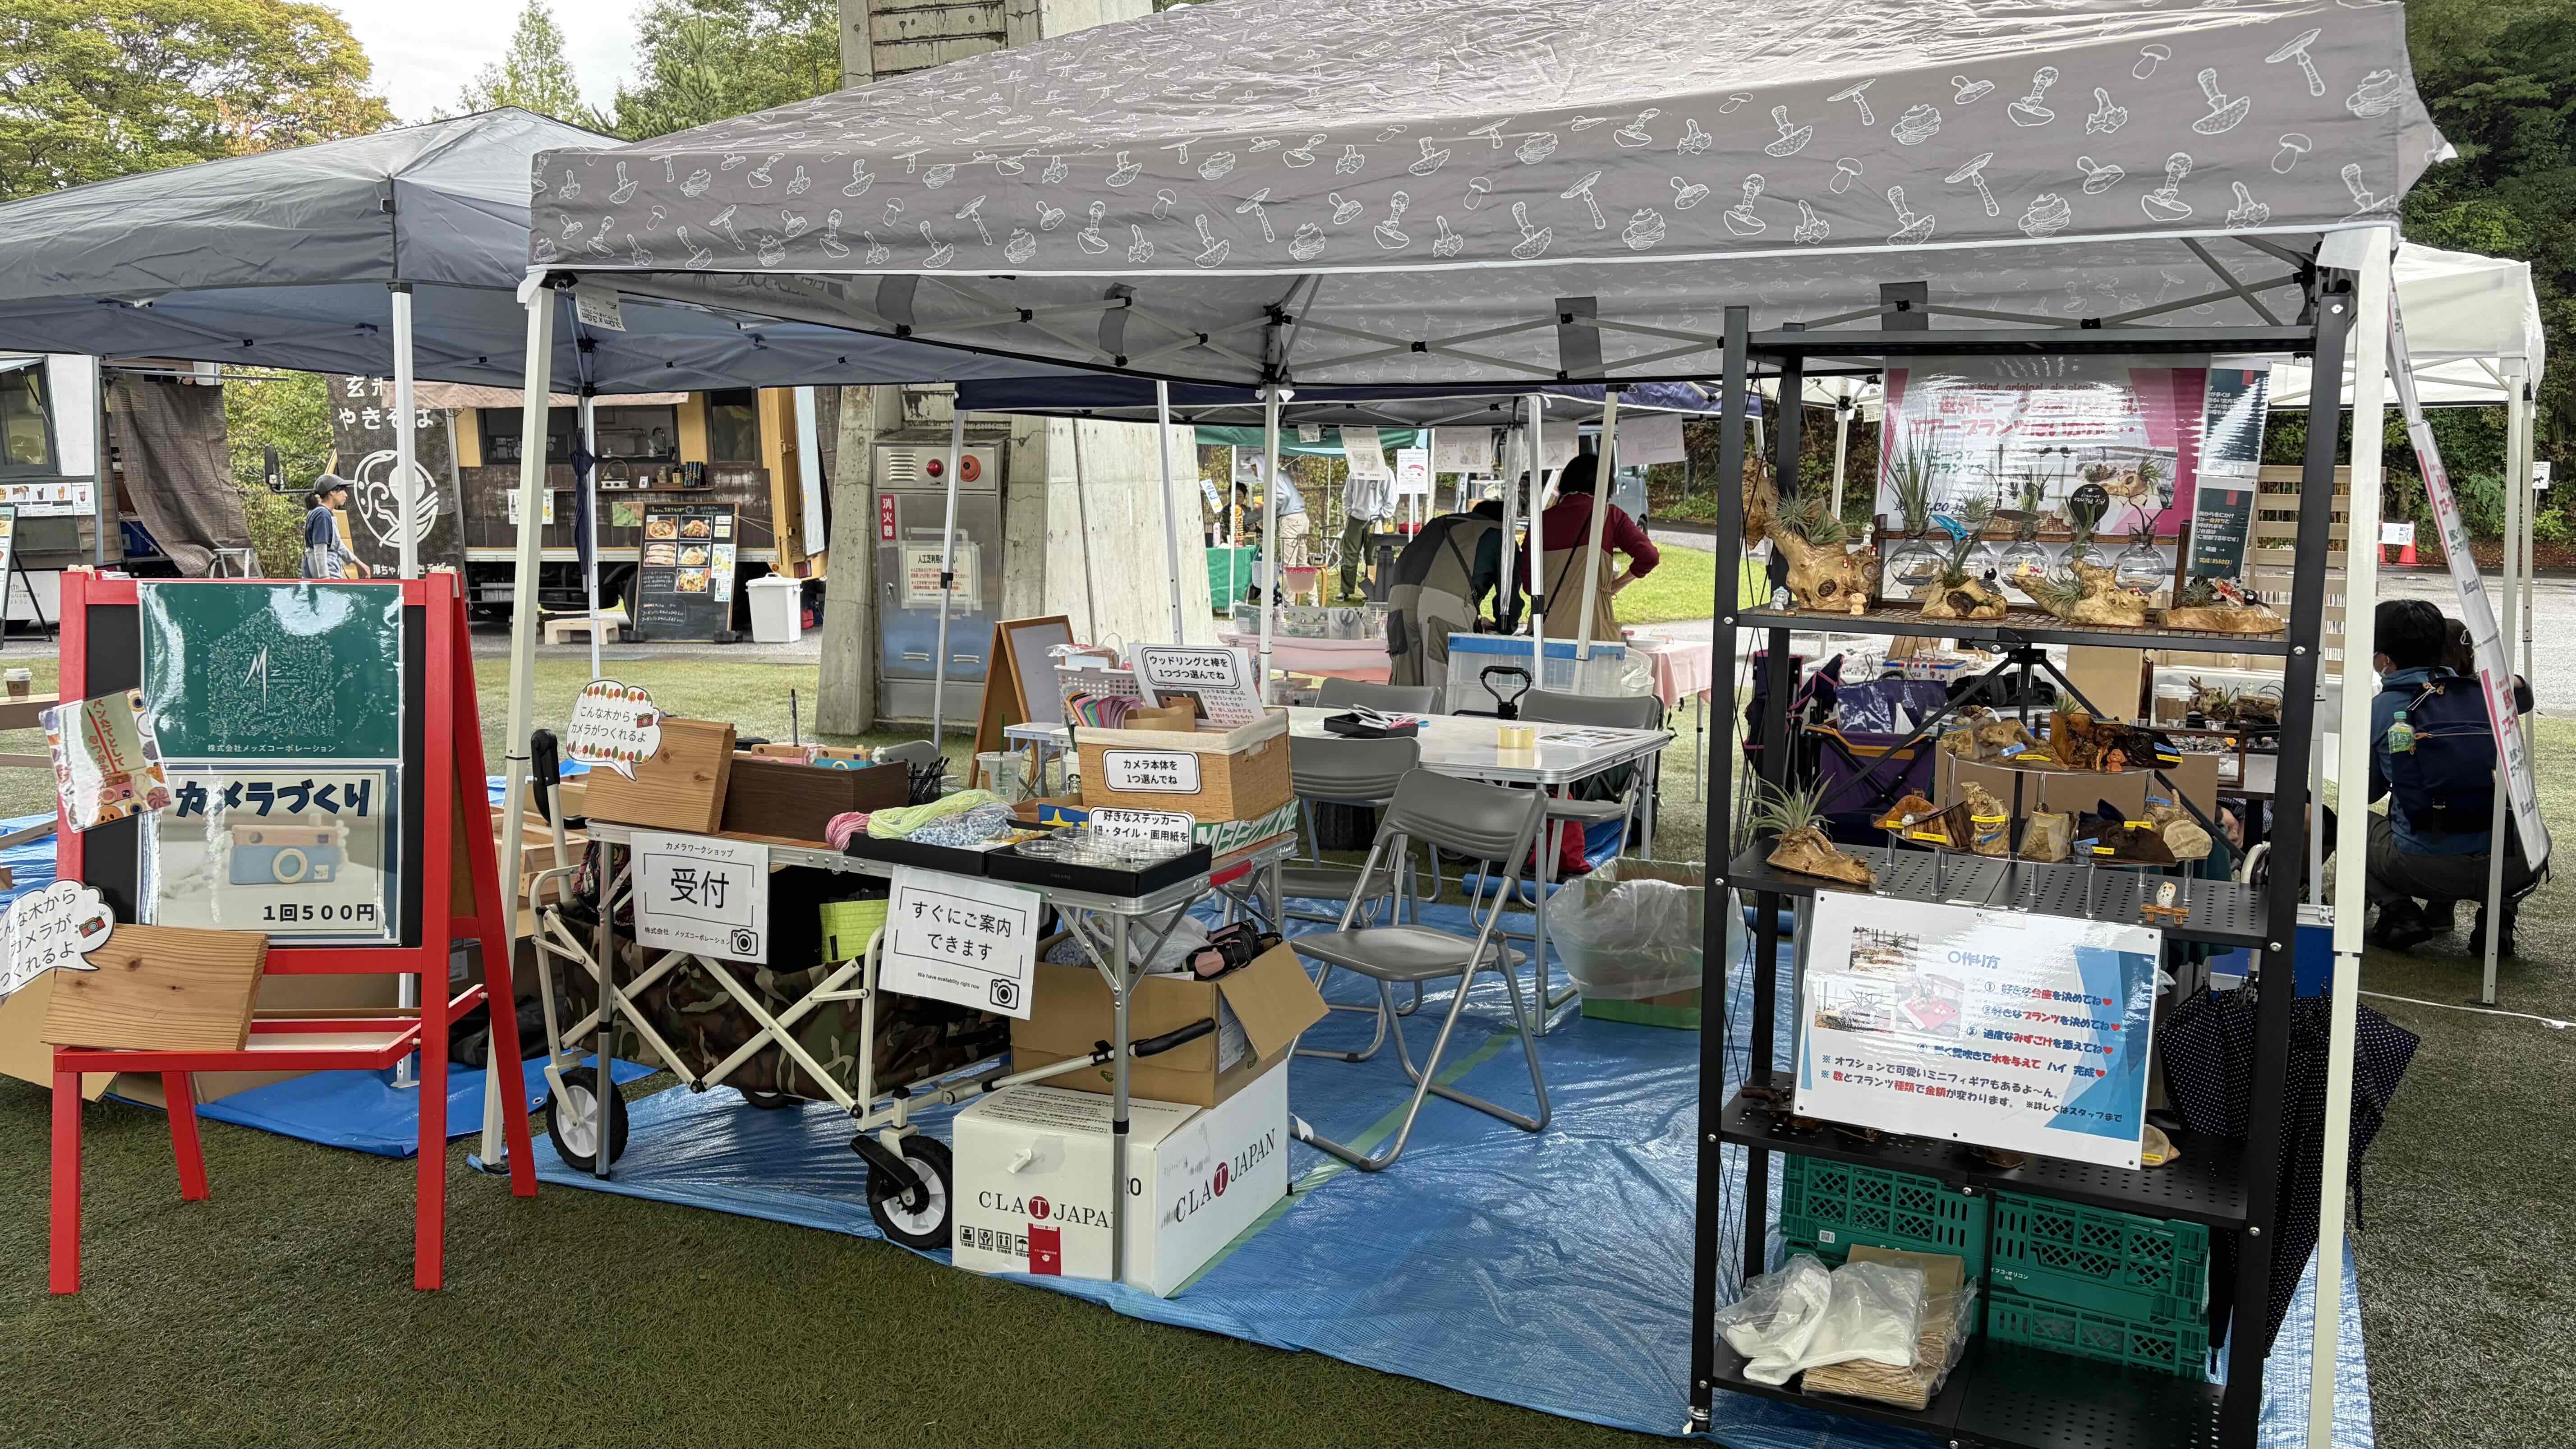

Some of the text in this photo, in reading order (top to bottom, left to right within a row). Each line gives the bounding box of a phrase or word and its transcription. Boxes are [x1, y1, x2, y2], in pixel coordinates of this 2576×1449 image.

[883, 498, 893, 537] 消火器
[1149, 655, 1229, 667] ウッドリングと棒を
[1159, 669, 1226, 680] 1つづつ選んでね
[580, 707, 630, 722] こんな木から
[571, 722, 647, 743] カメラがつくれるよ
[207, 744, 336, 752] 株式会社メッズコーポレーション
[1123, 759, 1178, 771] カメラ本体を
[1127, 774, 1178, 785] 1つ選んでね
[175, 779, 371, 818] カメラづくり
[1103, 810, 1180, 825] 好きなステッカー
[666, 842, 734, 857] カメラワークショップ
[670, 868, 730, 909] 受付
[0, 889, 76, 942] んな木から
[262, 903, 375, 922] 1回500円
[912, 901, 1012, 938] すぐにご案内
[11, 913, 72, 957] カメラが
[644, 926, 731, 946] 株式会社 メッズコーポレーション
[927, 933, 993, 961] できます
[937, 976, 960, 987] availability
[960, 980, 971, 989] right
[2073, 1066, 2095, 1078] 完成
[1230, 1127, 1276, 1182] JAPAN
[1053, 1204, 1113, 1230] JAPA
